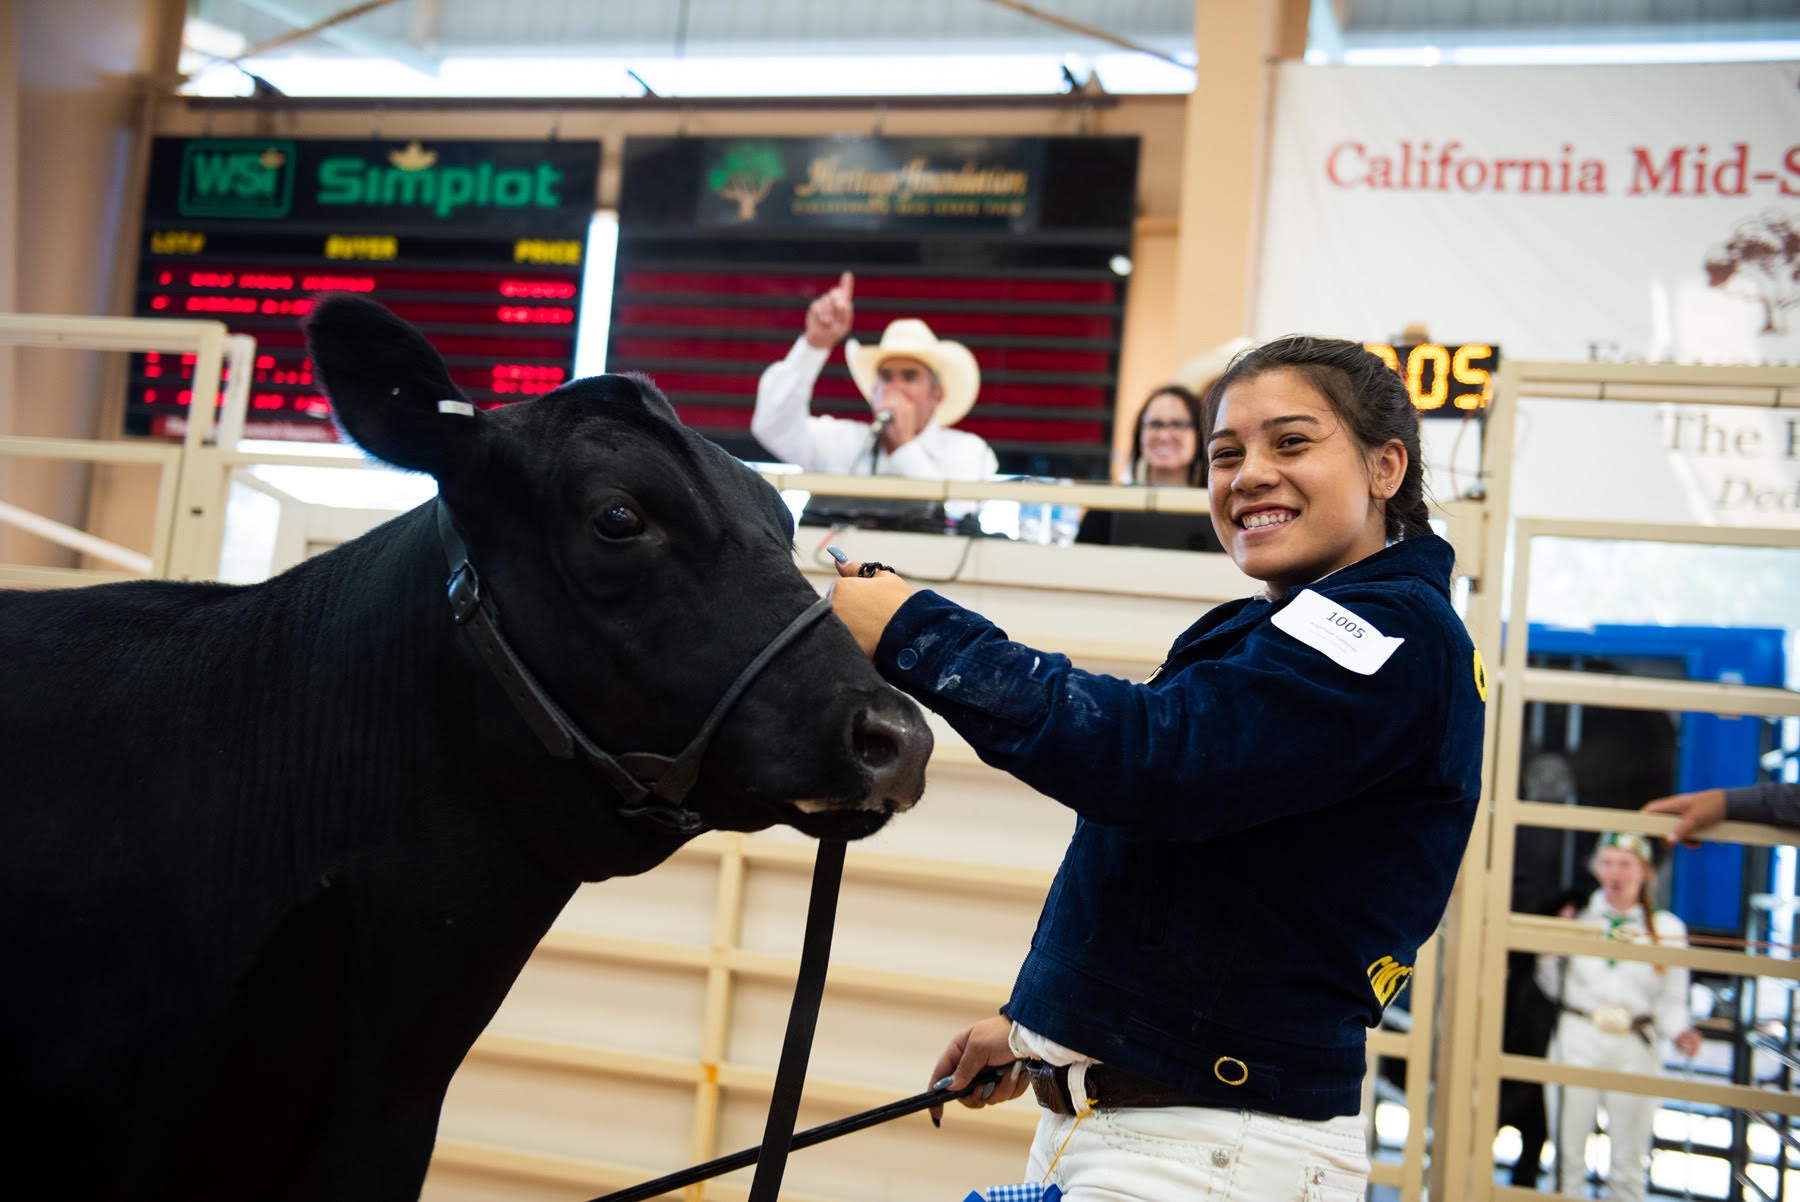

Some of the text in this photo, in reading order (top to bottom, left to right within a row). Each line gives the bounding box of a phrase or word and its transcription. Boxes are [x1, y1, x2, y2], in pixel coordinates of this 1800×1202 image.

[317, 155, 562, 218] Simplot
[1326, 140, 1607, 195] California
[515, 238, 581, 264] PRICE
[1656, 409, 1762, 457] The
[1325, 611, 1366, 640] 1005
